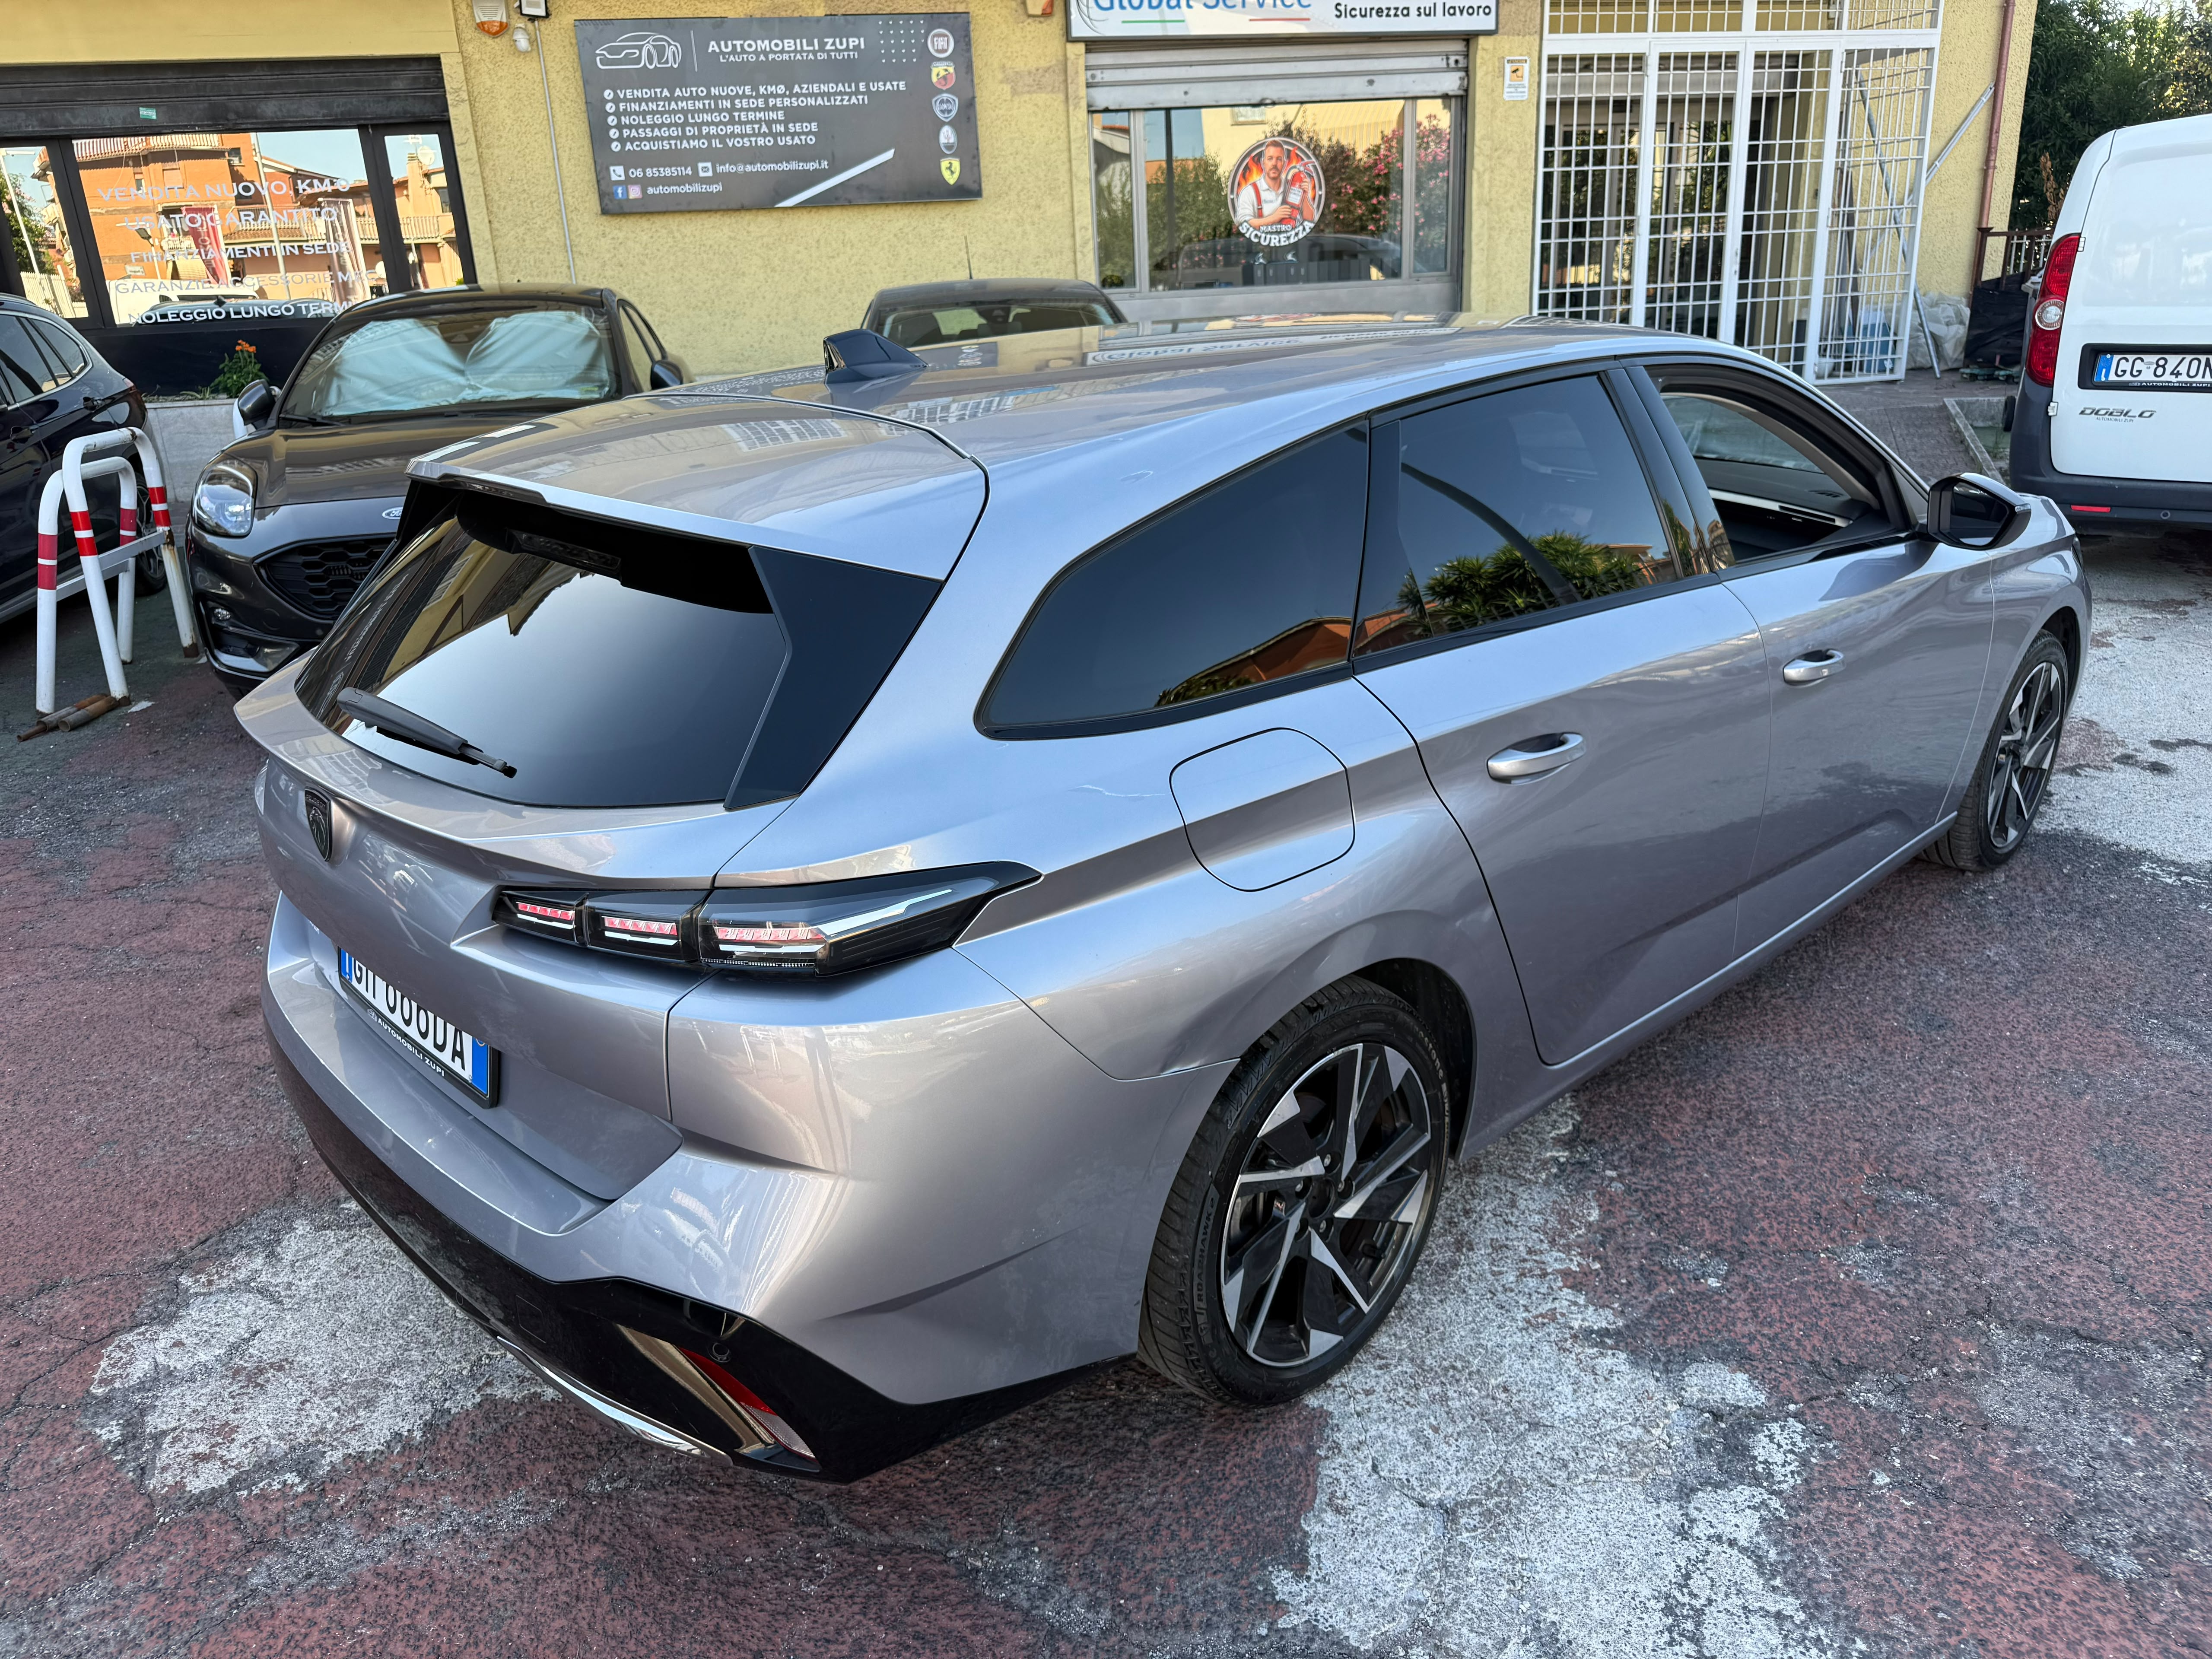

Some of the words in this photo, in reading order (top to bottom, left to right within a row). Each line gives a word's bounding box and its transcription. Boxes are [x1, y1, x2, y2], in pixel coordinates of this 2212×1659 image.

[1335, 3, 1410, 18] Sicurezza
[1416, 2, 1436, 17] sul
[1443, 2, 1491, 17] lavoro
[708, 38, 819, 52] AUTOMOBILI
[824, 37, 864, 50] ZUPI
[719, 54, 756, 62] L'AUTO
[769, 53, 814, 61] PORTATA
[617, 88, 670, 99] VENDITA
[674, 87, 707, 97] AUTO
[710, 86, 756, 96] NUOVE,
[793, 82, 855, 94] AZIENDALI
[859, 82, 866, 91] E
[869, 81, 906, 91] USATE
[619, 100, 714, 111] FINANZIAMENTI
[718, 99, 731, 109] IN
[734, 98, 765, 108] SEDE
[768, 95, 868, 108] PERSONALIZZATI
[620, 114, 684, 125] NOLEGGIO
[688, 112, 729, 123] LUNGO
[733, 111, 785, 121] TERMINE
[623, 127, 682, 138] PASSAGGI
[685, 126, 698, 136] DI
[702, 122, 769, 136] PROPRIETÀ
[772, 124, 784, 133] IN
[788, 122, 818, 133] SEDE
[625, 139, 708, 151] ACQUISTIAMO
[712, 138, 723, 148] IL
[726, 137, 774, 147] VOSTRO
[777, 135, 816, 146] USATO
[629, 168, 643, 178] 06
[646, 167, 692, 178] 85385114
[715, 159, 829, 174] info@automobilizupi.it
[97, 185, 200, 201] VENDITA
[647, 182, 723, 195] automobilizupi
[124, 214, 202, 230] USATO
[206, 207, 337, 226] GARANTITO
[1238, 220, 1315, 247] SICUREZZA
[131, 245, 276, 263] FINANZIAMENTI
[303, 242, 352, 255] SEDE
[115, 278, 214, 294] GARANZIE
[217, 273, 334, 288] ACCESSORIE
[128, 308, 226, 324] NOLEGGIO
[229, 304, 295, 319] LUNGO
[306, 794, 325, 808] PEUGEOT
[378, 1017, 423, 1059] AUTOMOBILI
[424, 1057, 445, 1077] ZUPI
[1197, 1212, 1212, 1302] ROADHAWK
